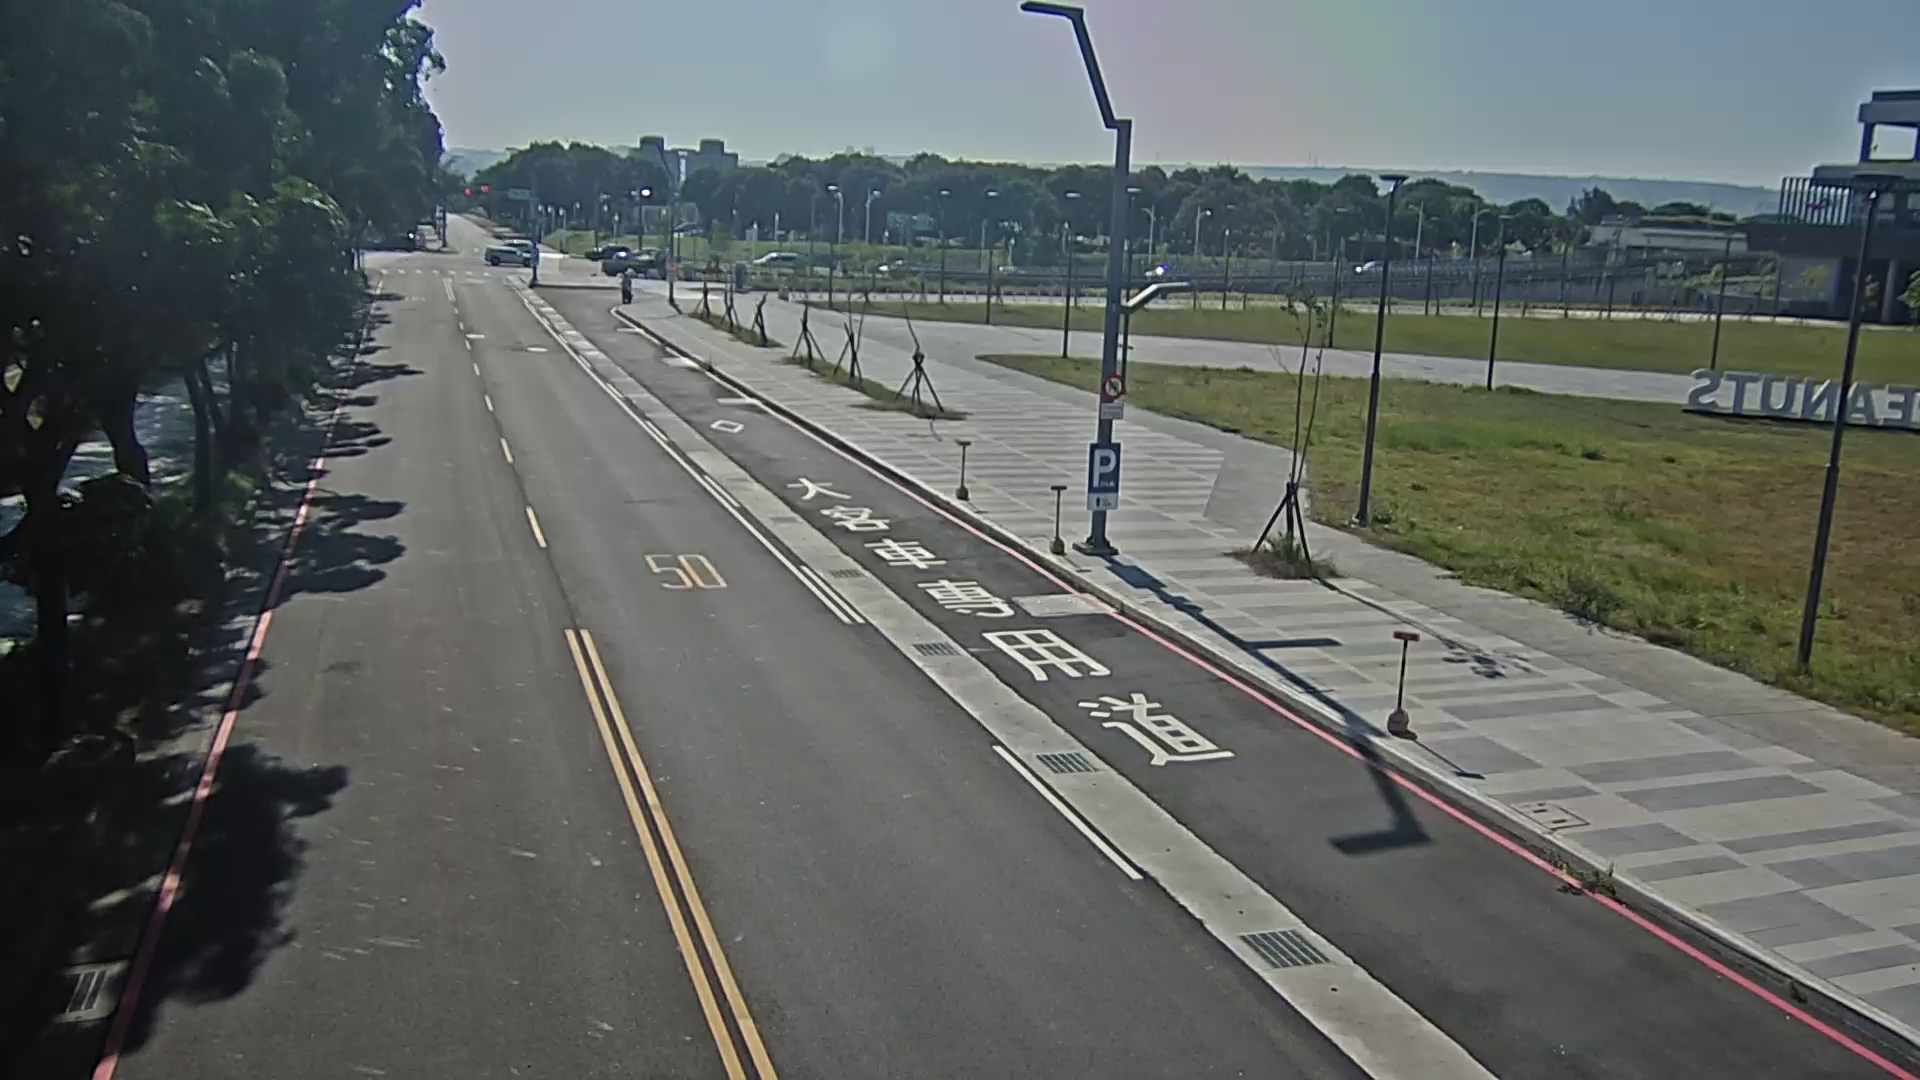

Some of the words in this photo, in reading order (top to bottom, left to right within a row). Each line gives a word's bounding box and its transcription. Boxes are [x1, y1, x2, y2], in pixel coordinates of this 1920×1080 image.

[1093, 449, 1117, 488] P
[644, 554, 727, 588] 50
[786, 478, 1235, 766] 大客車專用道
